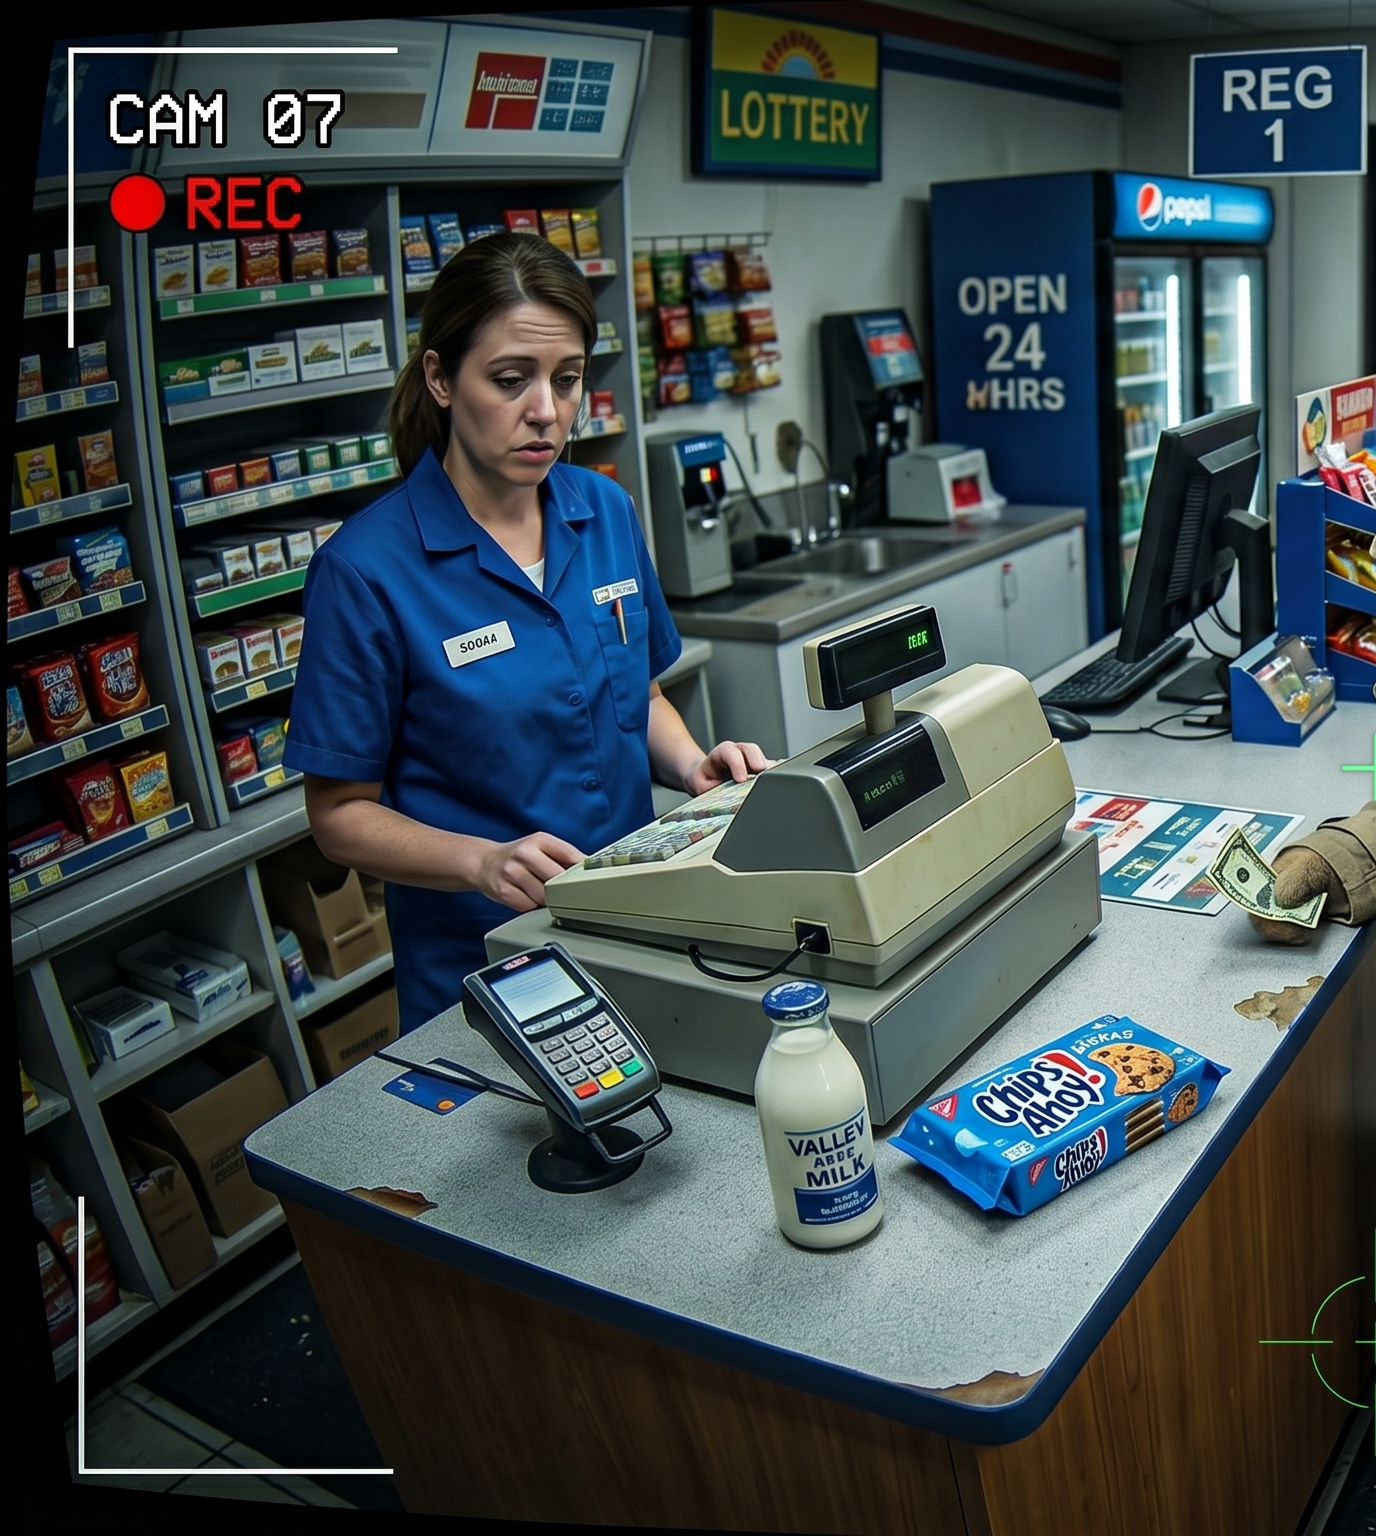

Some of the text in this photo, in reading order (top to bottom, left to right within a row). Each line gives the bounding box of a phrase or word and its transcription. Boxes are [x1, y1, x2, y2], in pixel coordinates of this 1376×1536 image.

[1223, 65, 1333, 112] REG
[721, 89, 869, 145] LOTTERY
[1264, 118, 1284, 163] 1
[1163, 193, 1213, 226] pepsi
[958, 273, 1067, 316] OPEN
[983, 321, 1046, 372] 24
[976, 1060, 1064, 1125] Chips
[806, 1153, 866, 1188] MILK
